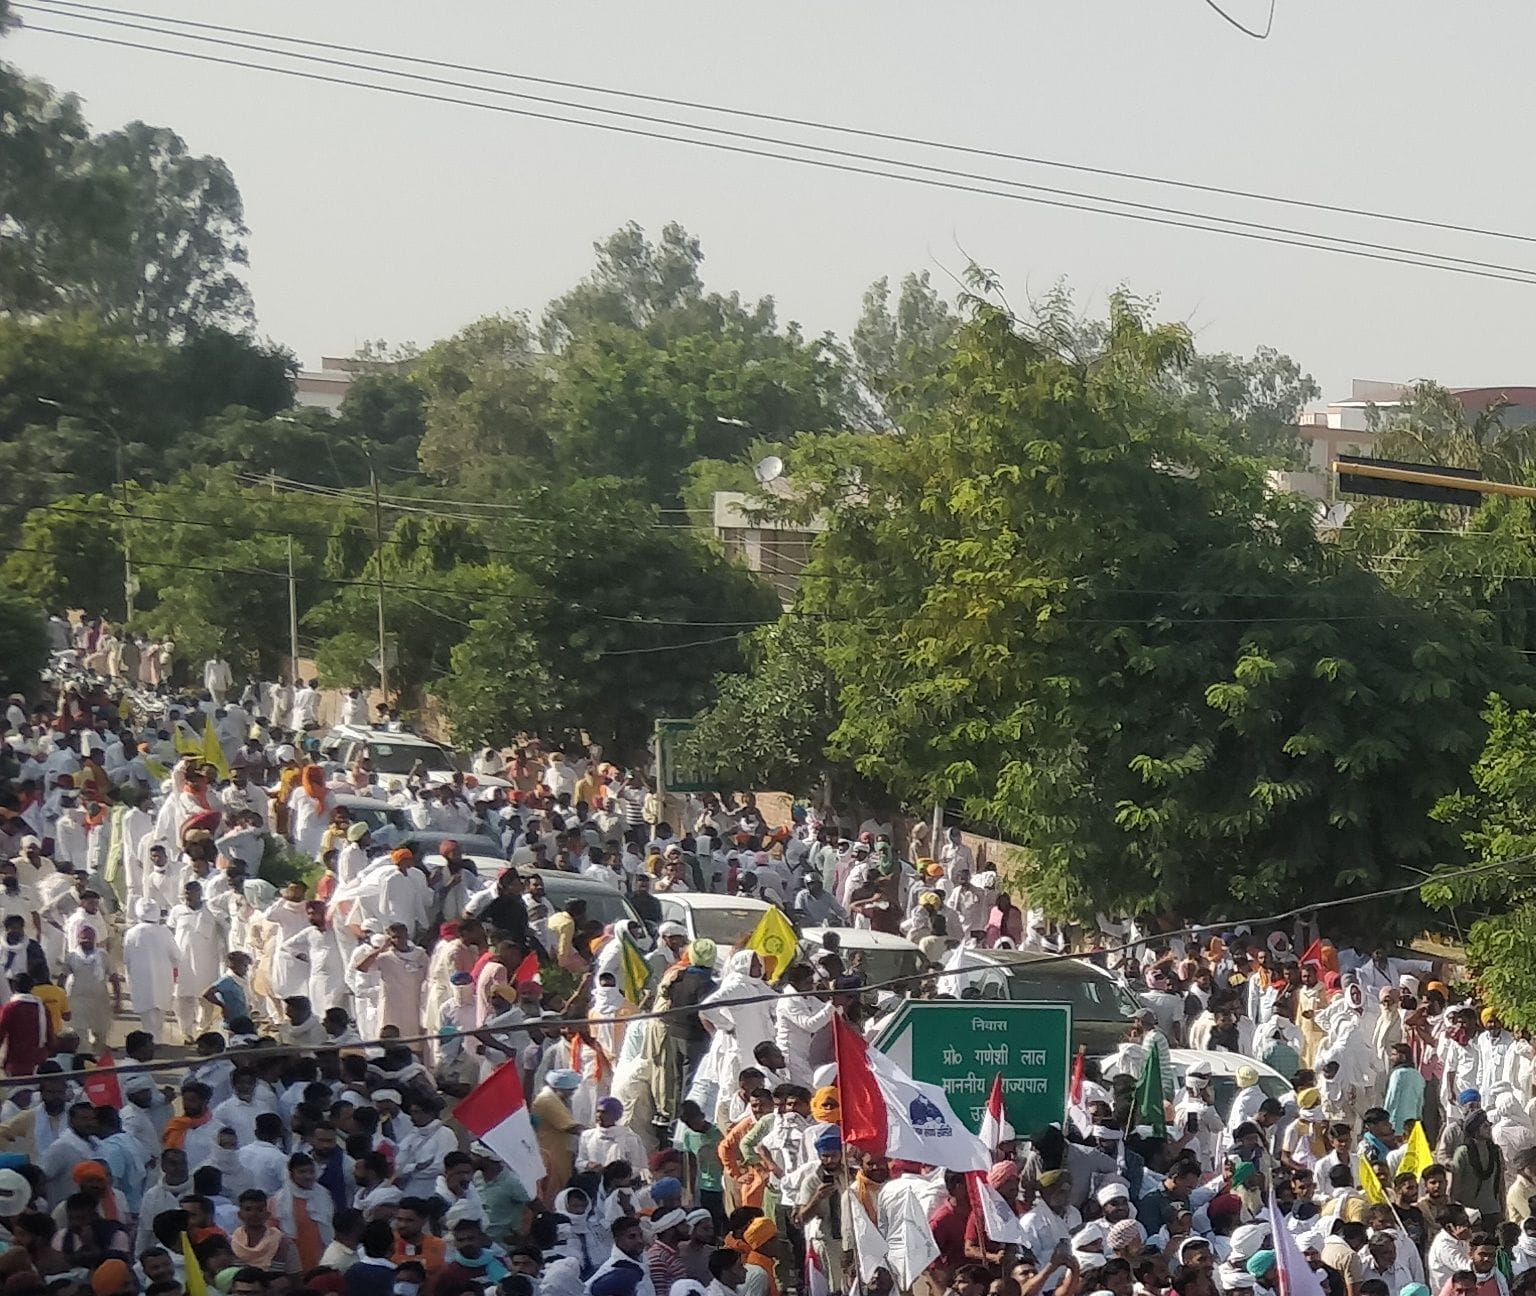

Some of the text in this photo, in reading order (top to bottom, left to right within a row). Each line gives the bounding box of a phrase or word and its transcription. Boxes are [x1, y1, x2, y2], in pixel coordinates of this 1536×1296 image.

[972, 1017, 1008, 1032] निवास
[974, 1042, 1009, 1065] गणेशी
[1020, 1050, 1047, 1065] लाल
[942, 1071, 987, 1094] माननीय
